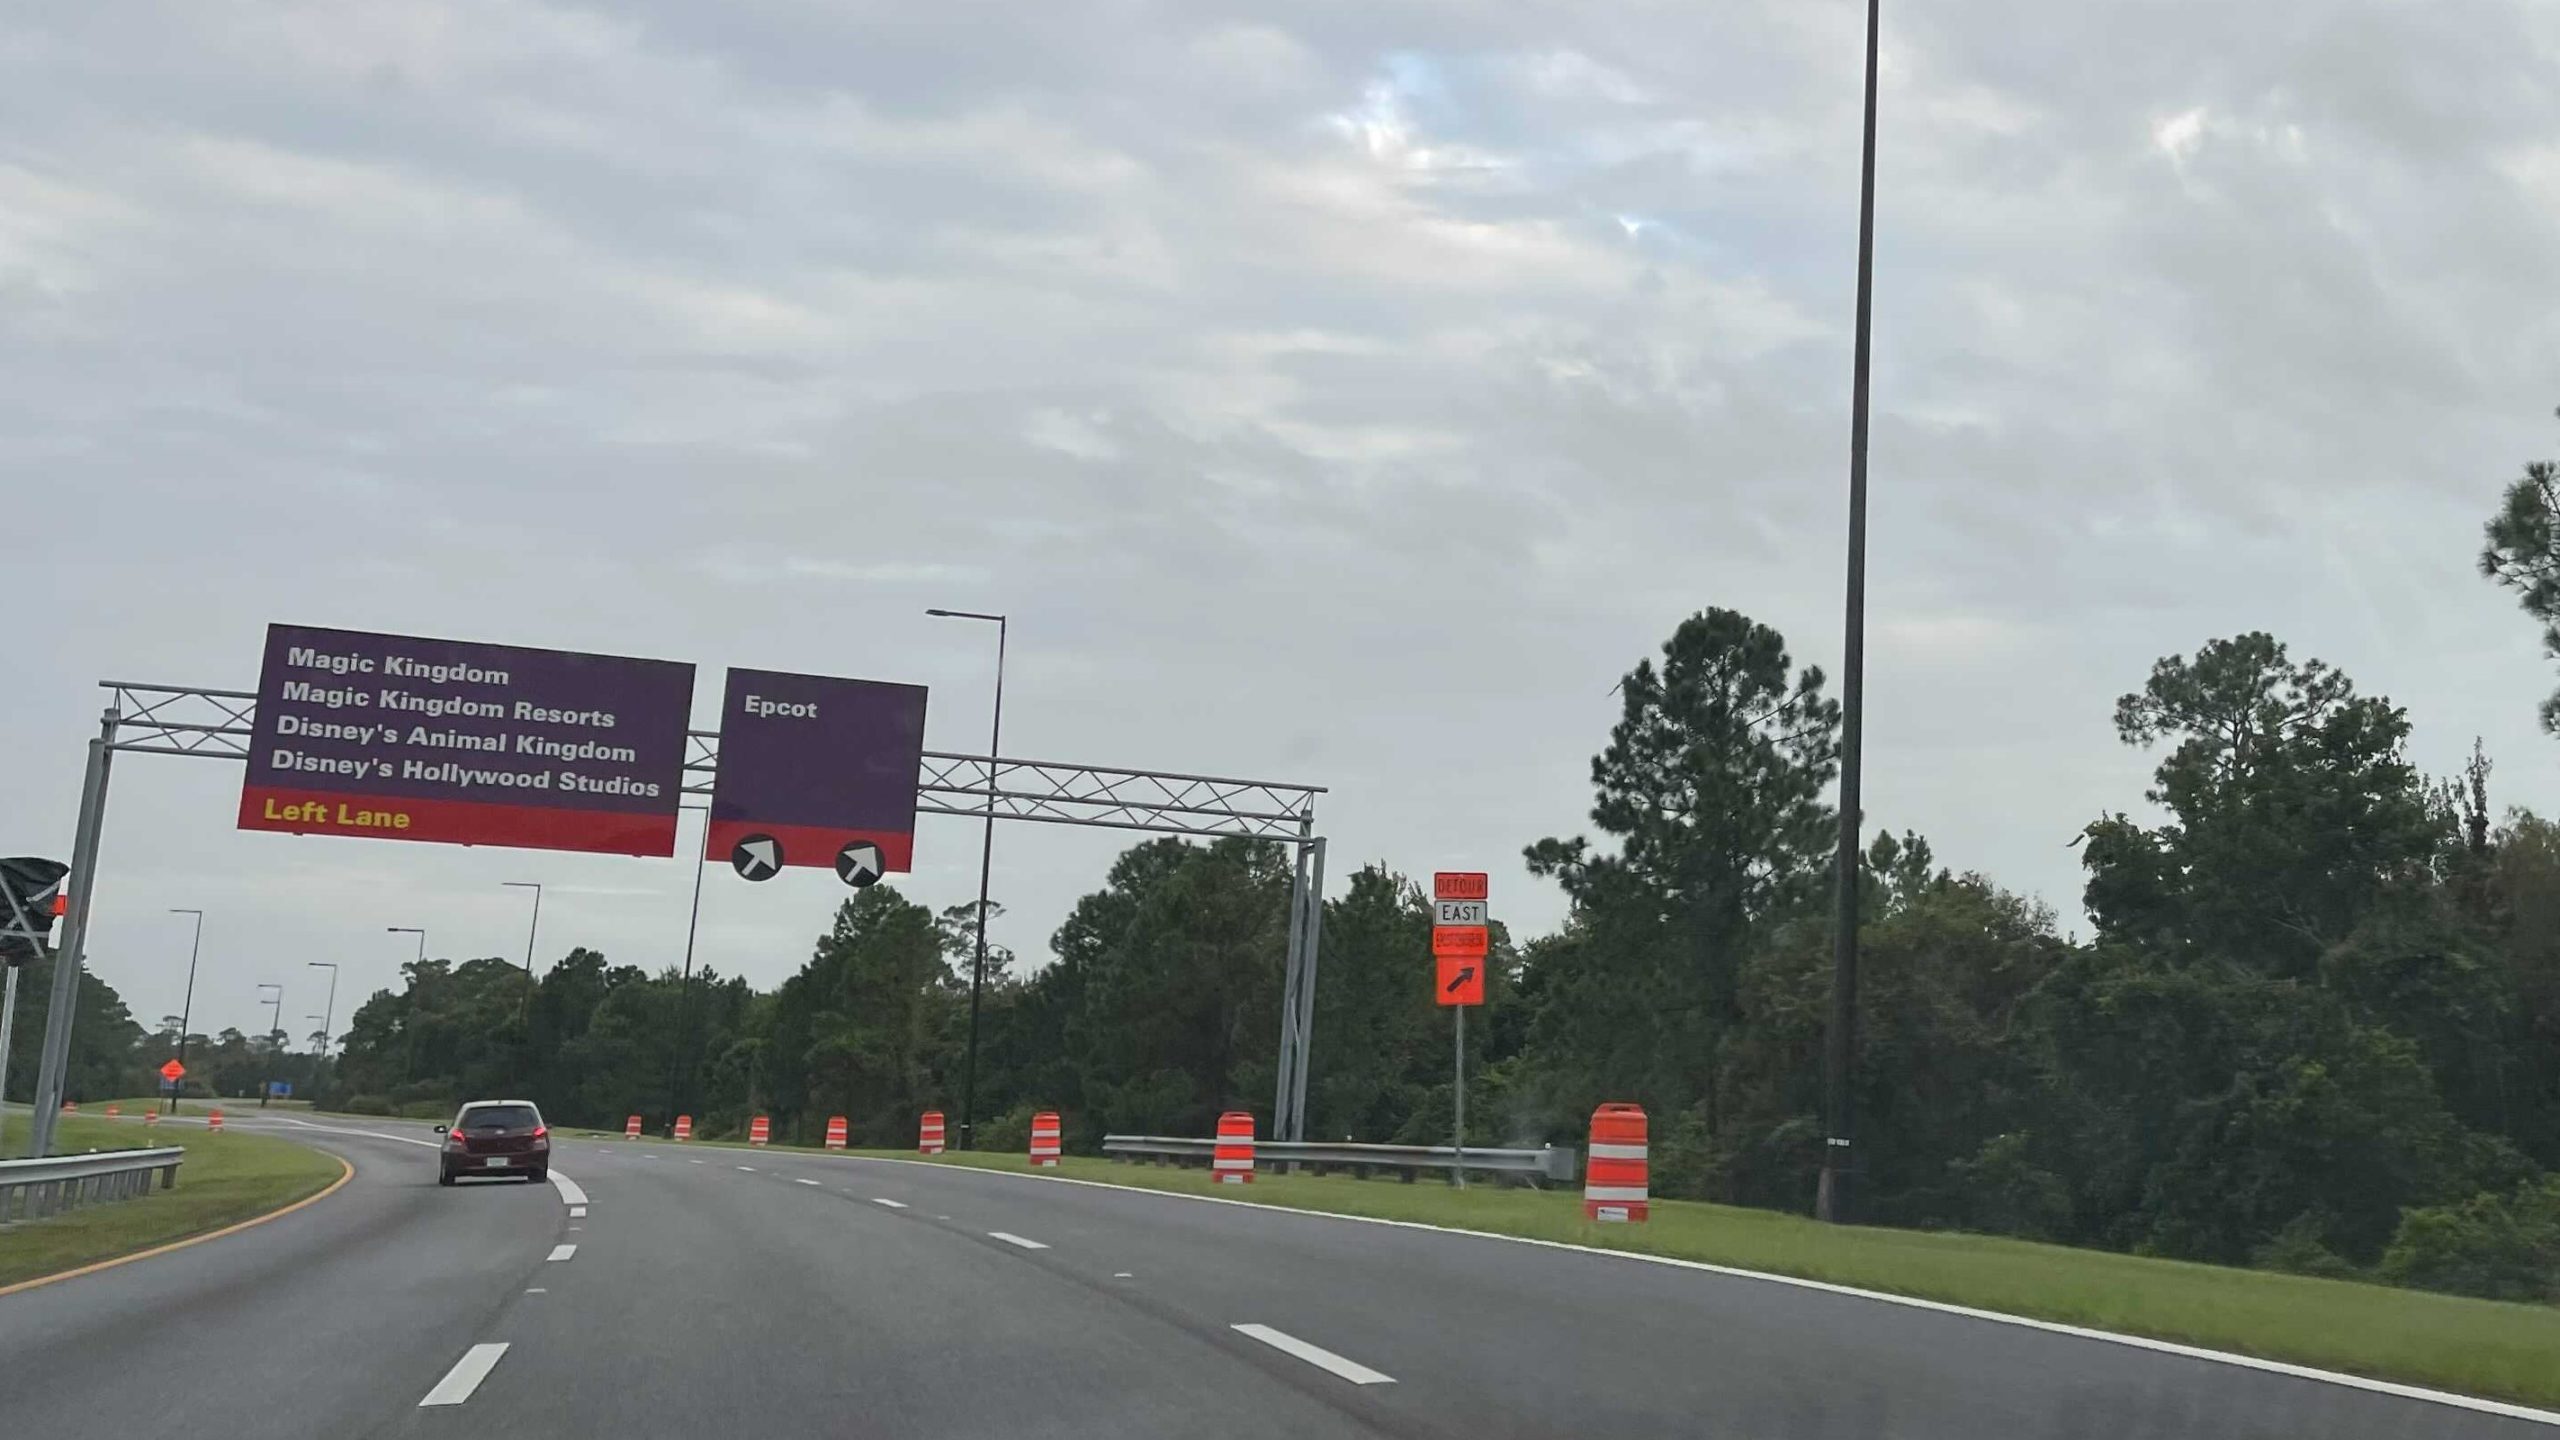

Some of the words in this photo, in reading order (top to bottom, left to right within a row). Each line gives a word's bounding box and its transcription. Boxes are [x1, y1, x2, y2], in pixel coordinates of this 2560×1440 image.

[288, 647, 375, 675] Magic
[384, 656, 509, 685] Kingdom
[282, 681, 370, 709] Magic
[379, 689, 504, 718] Kingdom
[513, 701, 615, 728] Resorts
[744, 694, 818, 719] Epcot
[277, 715, 398, 745] Disney's
[406, 726, 507, 752] Animal
[516, 734, 635, 762] Kingdom
[271, 749, 393, 779] Disney's
[402, 759, 550, 789] Hollywood
[558, 771, 660, 797] Studios
[264, 798, 328, 824] Left
[337, 804, 411, 829] Lane
[1438, 878, 1484, 894] DETOUR
[1442, 904, 1480, 921] EAST
